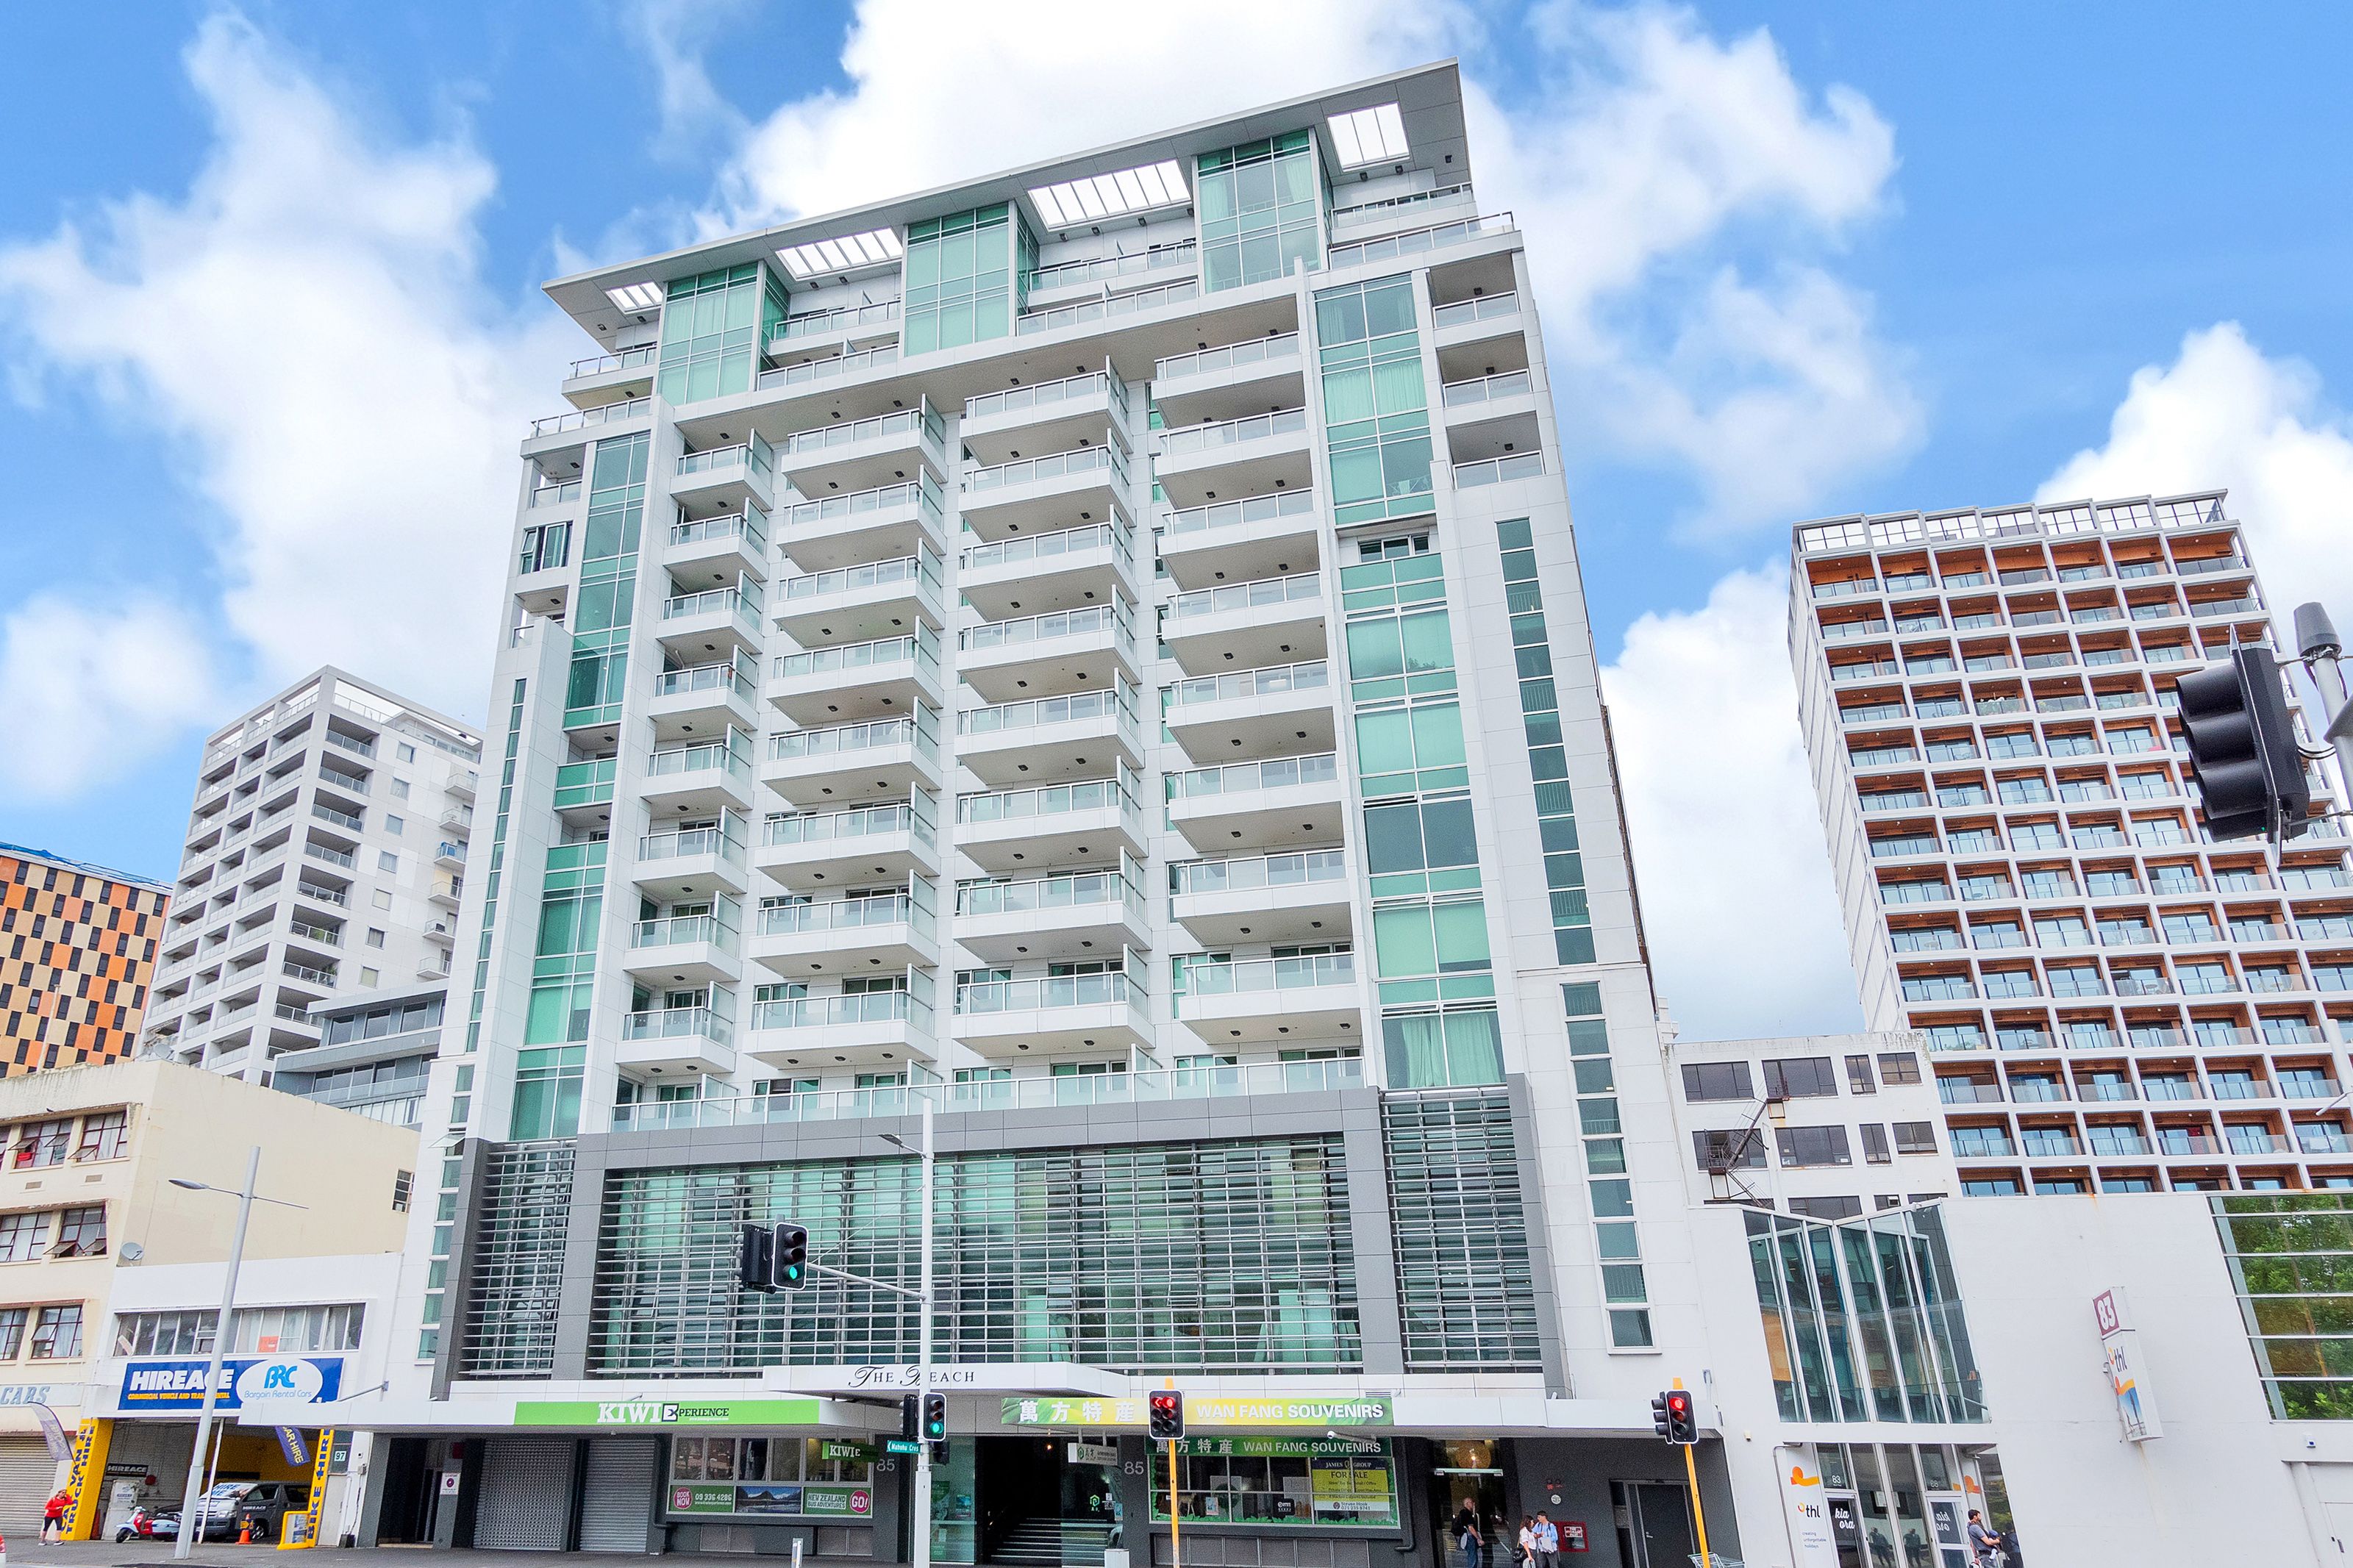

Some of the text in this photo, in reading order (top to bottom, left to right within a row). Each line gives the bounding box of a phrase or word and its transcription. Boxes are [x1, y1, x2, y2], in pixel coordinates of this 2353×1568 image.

[2097, 1295, 2115, 1331] 83
[2114, 1346, 2127, 1372] thl
[264, 1364, 298, 1389] BRC
[0, 1386, 50, 1405] CARS
[244, 1389, 313, 1400] Bargain Rental Cars
[597, 1403, 662, 1423] KIWI
[1196, 1404, 1384, 1419] WAN FANG SOUVENIRS
[290, 1440, 304, 1464] HIRE
[909, 1444, 919, 1452] Cres
[1243, 1442, 1381, 1453] WAN FANG SOUVENIRS
[335, 1452, 345, 1461] 97
[70, 1450, 82, 1486] VAN
[876, 1458, 896, 1472] 85
[1124, 1461, 1144, 1475] 85
[65, 1426, 95, 1534] TRUCK HIRE
[1832, 1475, 1841, 1483] 83
[676, 1497, 690, 1506] NOW
[820, 1494, 846, 1503] ZEALAND
[851, 1496, 868, 1508] GO!
[307, 1486, 321, 1539] BIKE
[1806, 1505, 1820, 1518] thl
[1835, 1508, 1849, 1519] kia
[1840, 1521, 1855, 1529] ora
